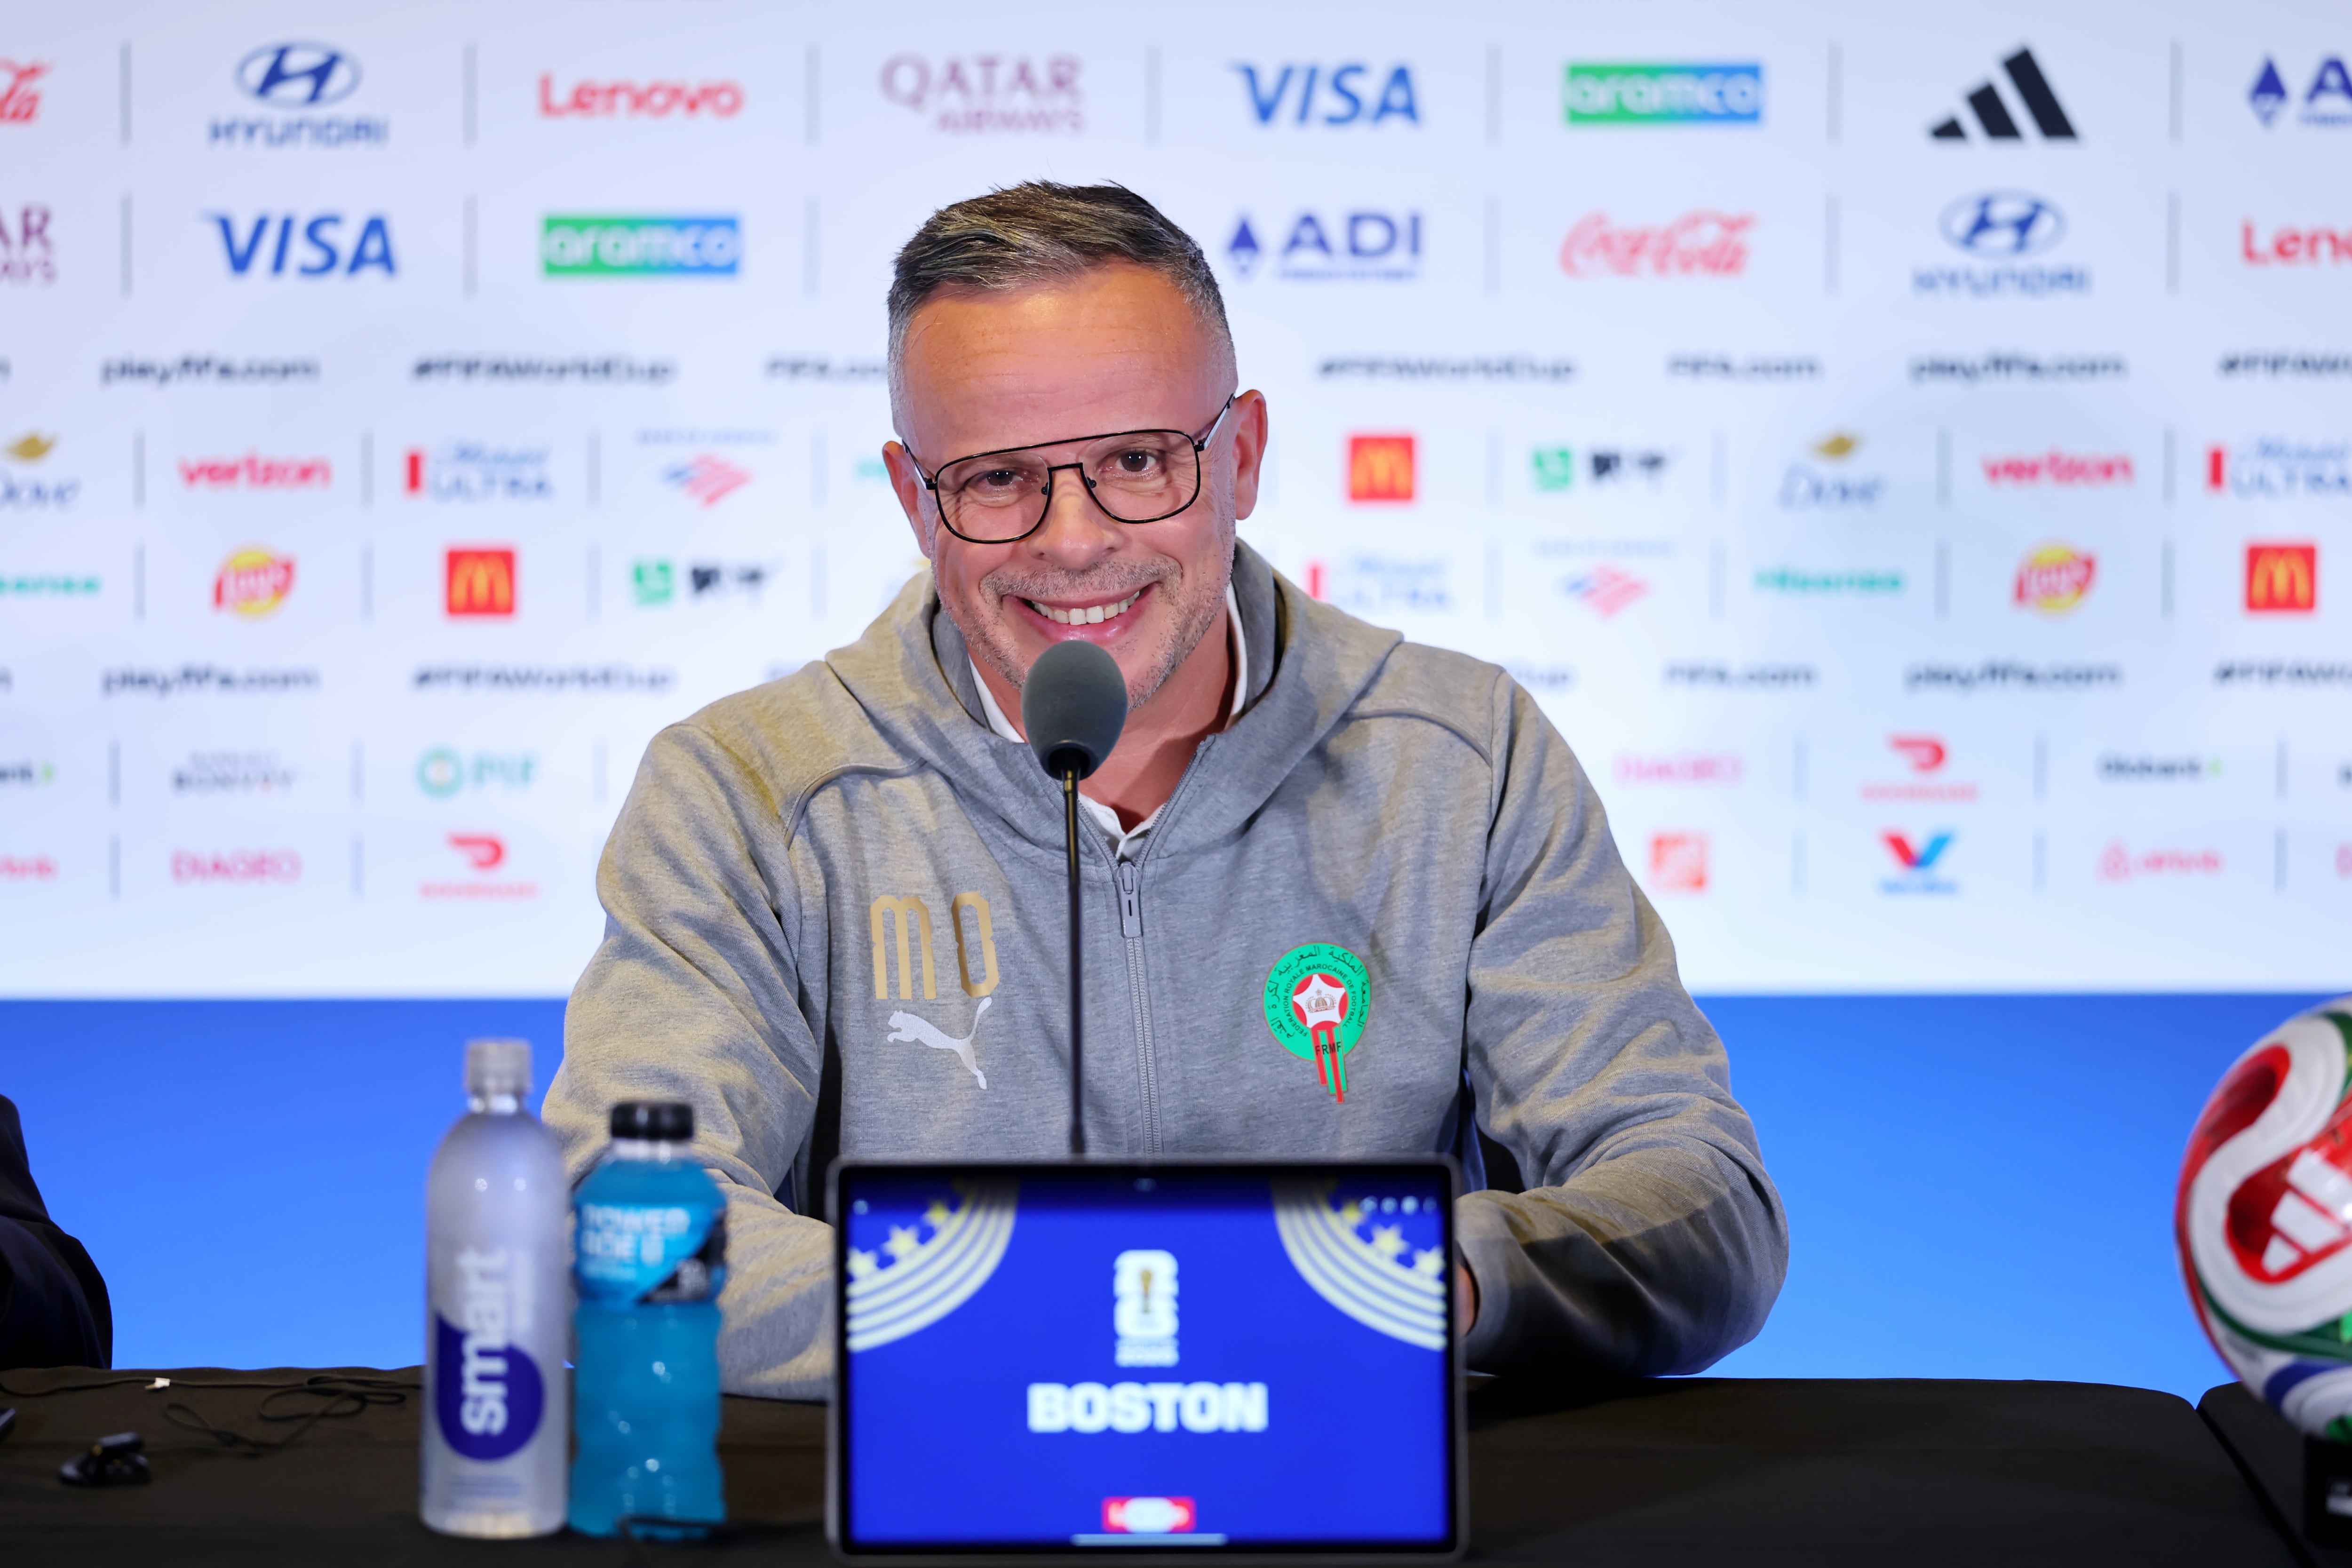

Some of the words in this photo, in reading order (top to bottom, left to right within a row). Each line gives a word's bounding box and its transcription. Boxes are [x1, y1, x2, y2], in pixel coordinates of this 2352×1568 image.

[537, 72, 744, 118] Lenovo
[880, 54, 1082, 111] QATAR
[1230, 63, 1421, 127] VISA
[1564, 72, 1761, 115] aramco
[208, 212, 397, 278] VISA
[545, 225, 739, 267] aramco
[1280, 211, 1422, 262] ADI
[2241, 220, 2352, 265] Len
[179, 453, 331, 488] verizon
[1983, 450, 2134, 485] verizon
[1284, 969, 1305, 994] ROYALE
[1305, 963, 1348, 980] MAROCAINE
[1346, 979, 1354, 990] DE
[1283, 995, 1308, 1037] FEDERATION
[1343, 990, 1357, 1028] FOOTBALL
[1314, 1041, 1342, 1056] FRMF
[456, 1247, 510, 1437] smart
[1027, 1381, 1269, 1434] BOSTON
